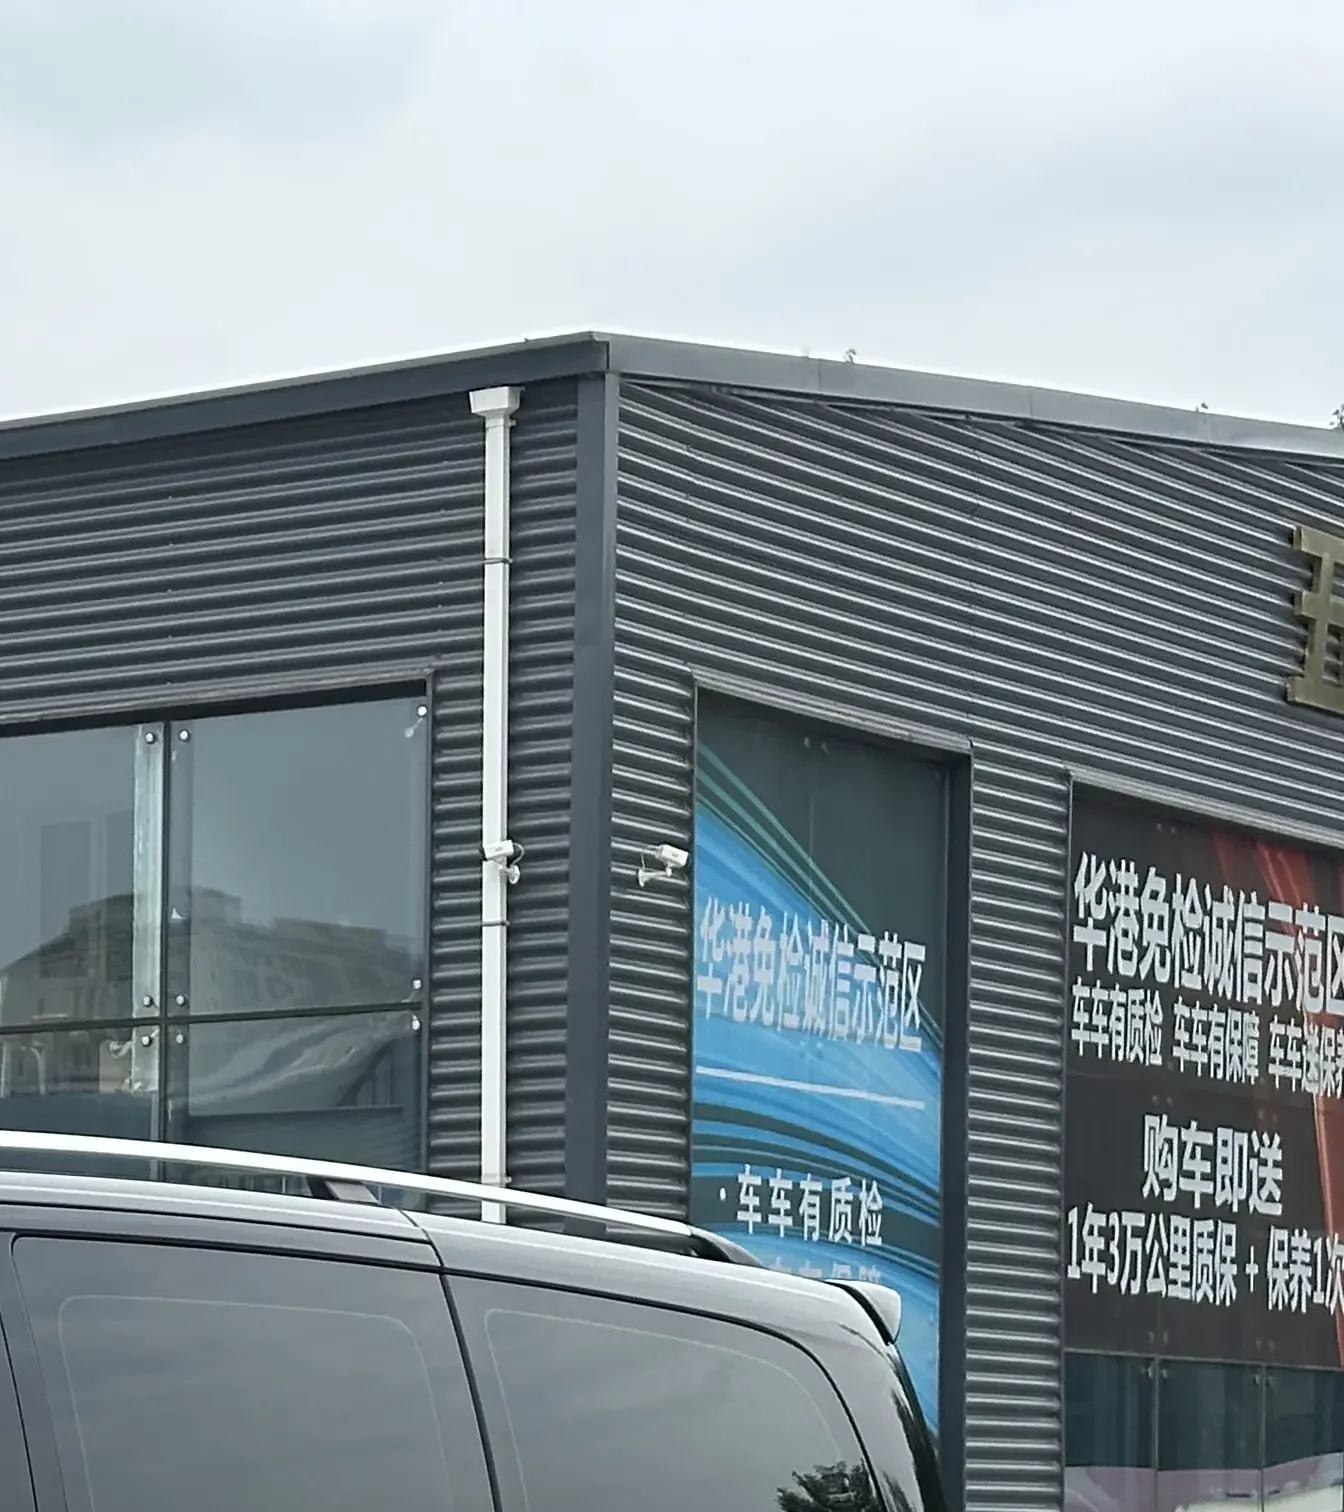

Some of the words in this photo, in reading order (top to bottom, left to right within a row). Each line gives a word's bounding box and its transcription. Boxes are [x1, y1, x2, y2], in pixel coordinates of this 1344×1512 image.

[697, 897, 926, 1052] 华港免检诚信示范区
[1072, 976, 1163, 1067] 车车有质检
[1172, 995, 1259, 1085] 车车有保障
[736, 1163, 883, 1247] 车车有质检
[1142, 1113, 1283, 1216] 购车即送
